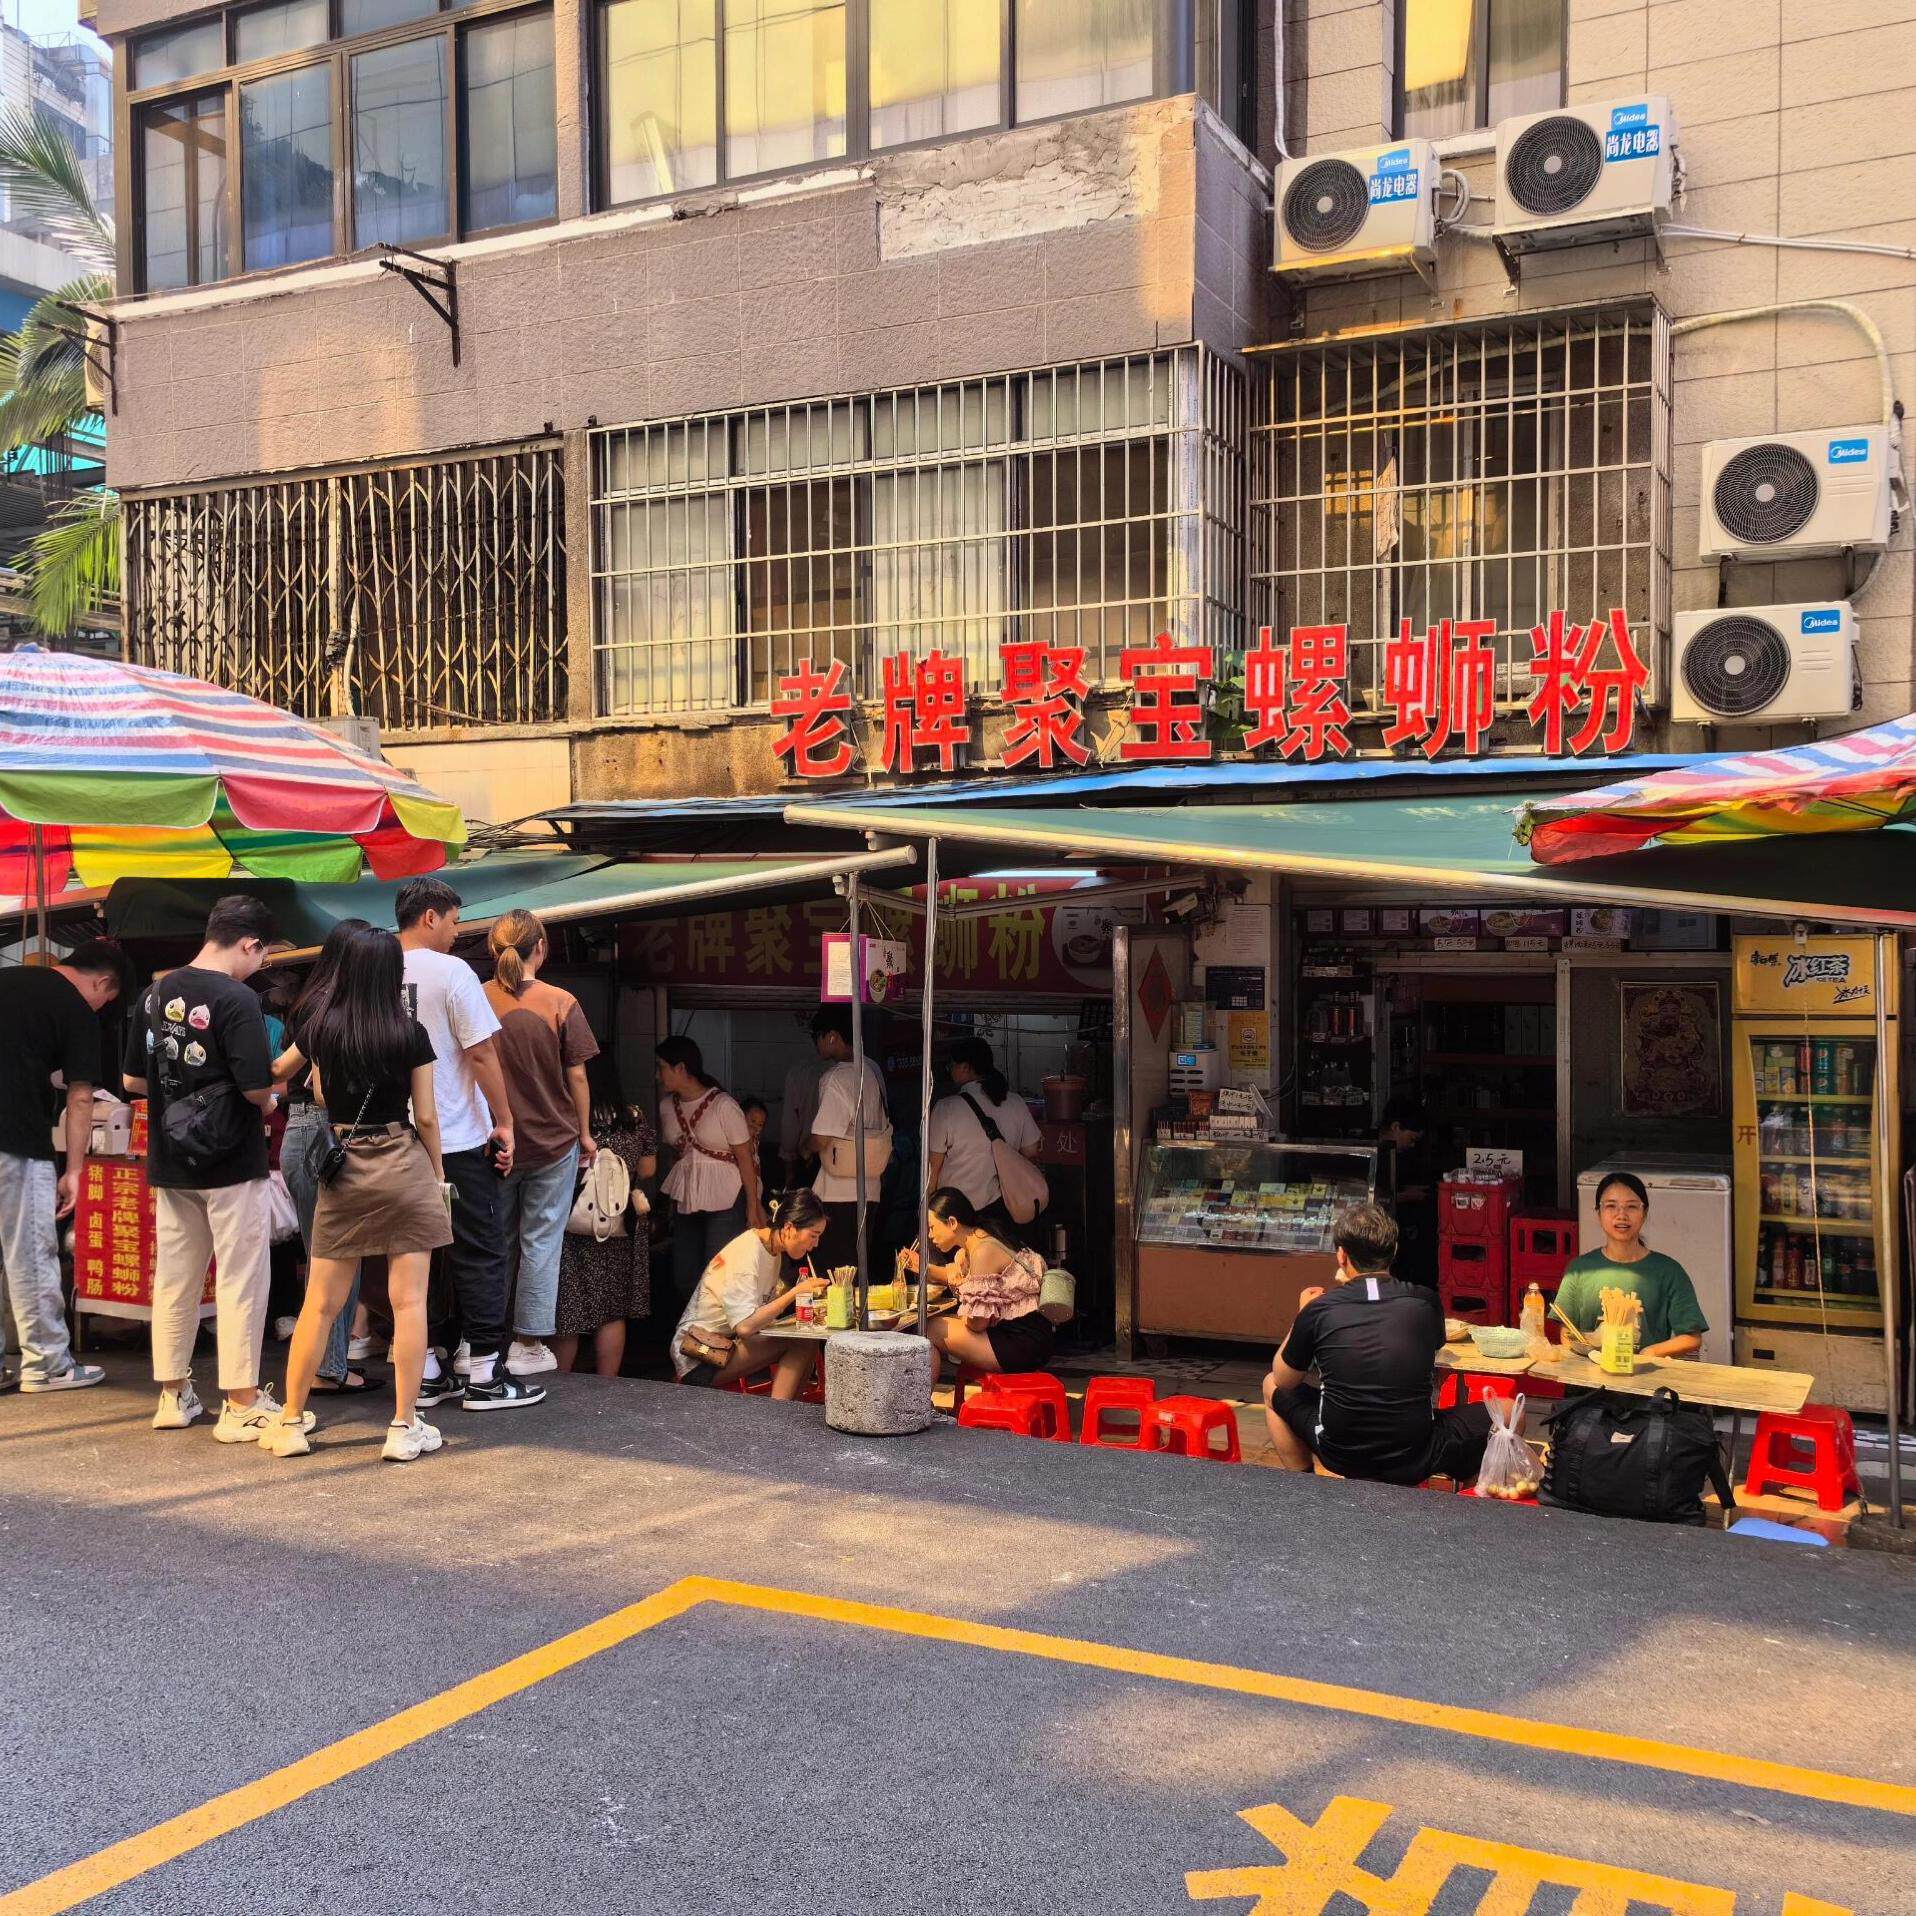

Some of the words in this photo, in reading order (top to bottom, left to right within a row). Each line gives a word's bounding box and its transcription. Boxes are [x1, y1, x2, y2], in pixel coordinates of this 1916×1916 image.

[1614, 112, 1646, 125] Midea
[1606, 129, 1658, 158] 尚龙电器
[1370, 173, 1417, 200] 尚龙电器
[1830, 446, 1867, 459] Midea
[1803, 616, 1838, 629] Midea
[770, 607, 1648, 778] 老牌聚宝螺蛳粉
[1784, 955, 1850, 988] 冰红茶
[1736, 1125, 1757, 1146] 开
[1473, 1152, 1511, 1167] 2.5元
[111, 1166, 140, 1298] 正宗老牌聚宝螺蛳粉
